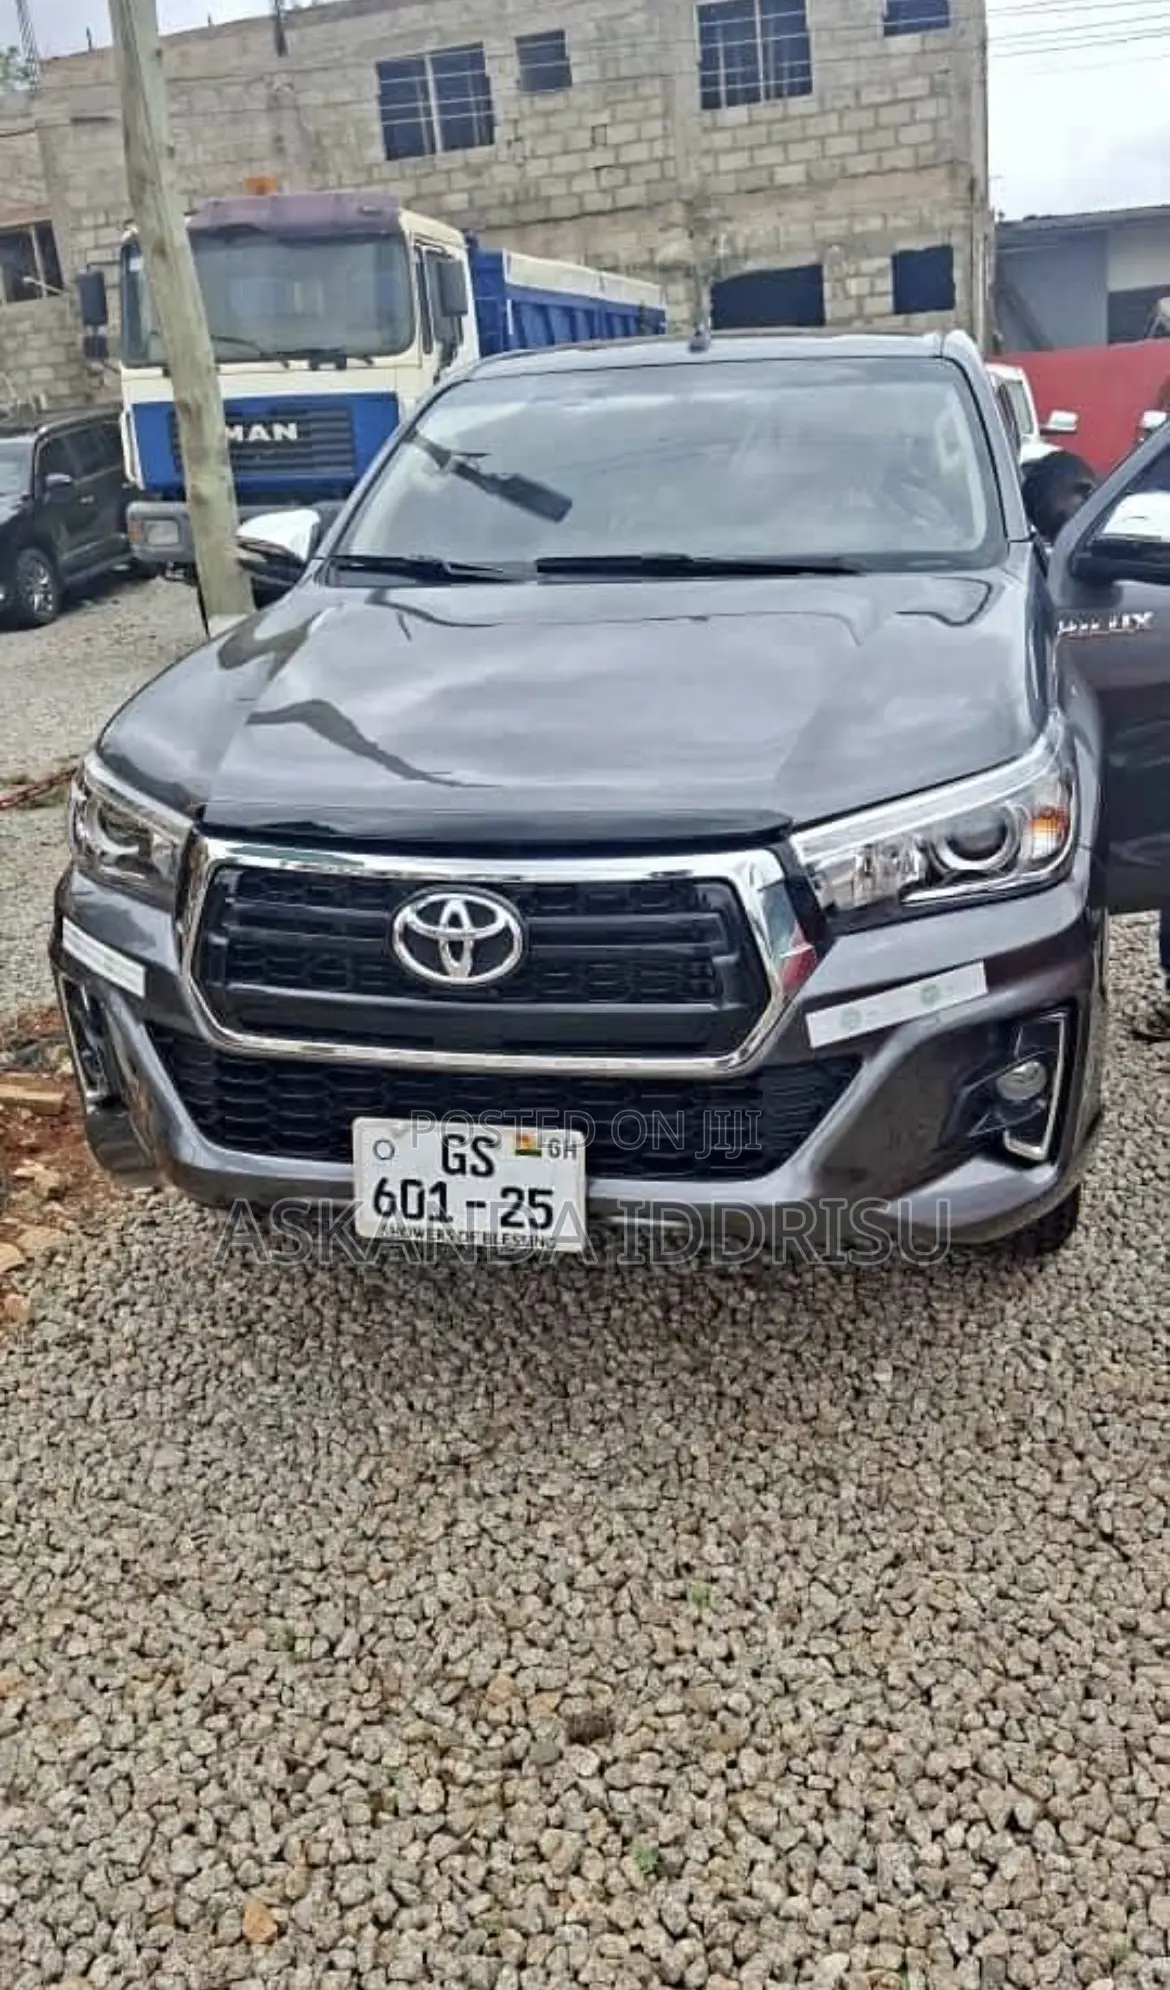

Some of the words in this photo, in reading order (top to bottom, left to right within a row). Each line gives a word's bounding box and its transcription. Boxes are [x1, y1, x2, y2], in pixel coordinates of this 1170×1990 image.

[225, 422, 298, 442] MAN
[441, 1133, 495, 1178] GS
[547, 1139, 577, 1160] GH
